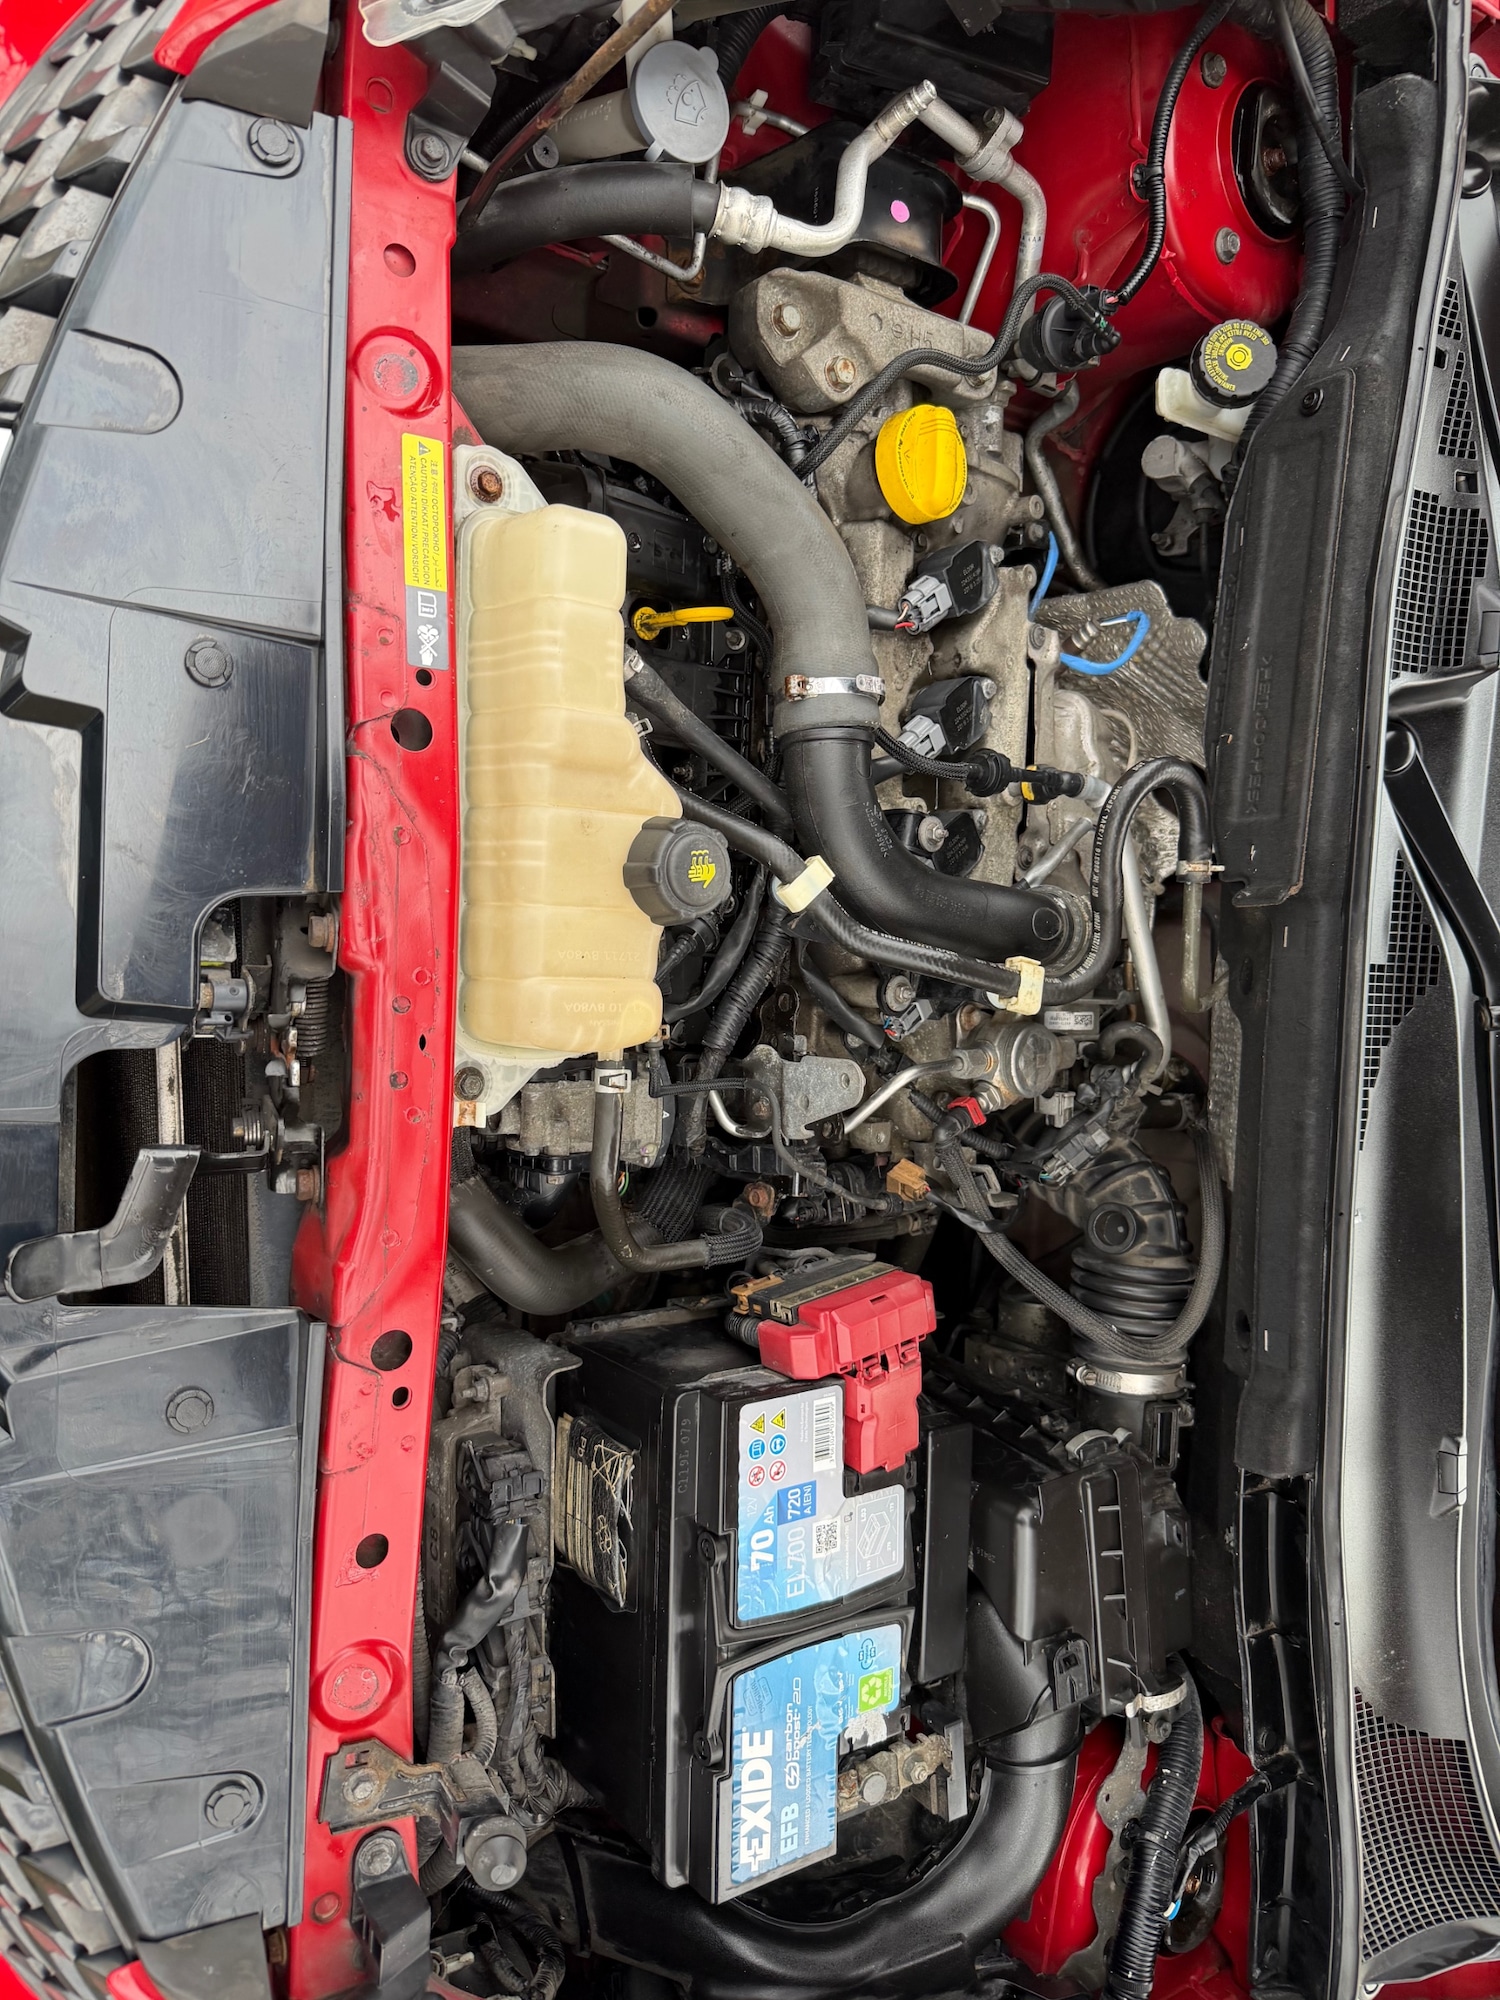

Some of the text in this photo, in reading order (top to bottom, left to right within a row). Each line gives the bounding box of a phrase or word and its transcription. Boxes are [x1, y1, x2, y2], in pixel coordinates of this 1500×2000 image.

[787, 1487, 801, 1520] 720
[751, 1506, 775, 1572] 70 Ah
[787, 1526, 806, 1599] EL700
[785, 1702, 793, 1761] carbon
[805, 1748, 813, 1776] BATTERY
[739, 1729, 773, 1872] EXIDE
[780, 1802, 799, 1855] EFB
